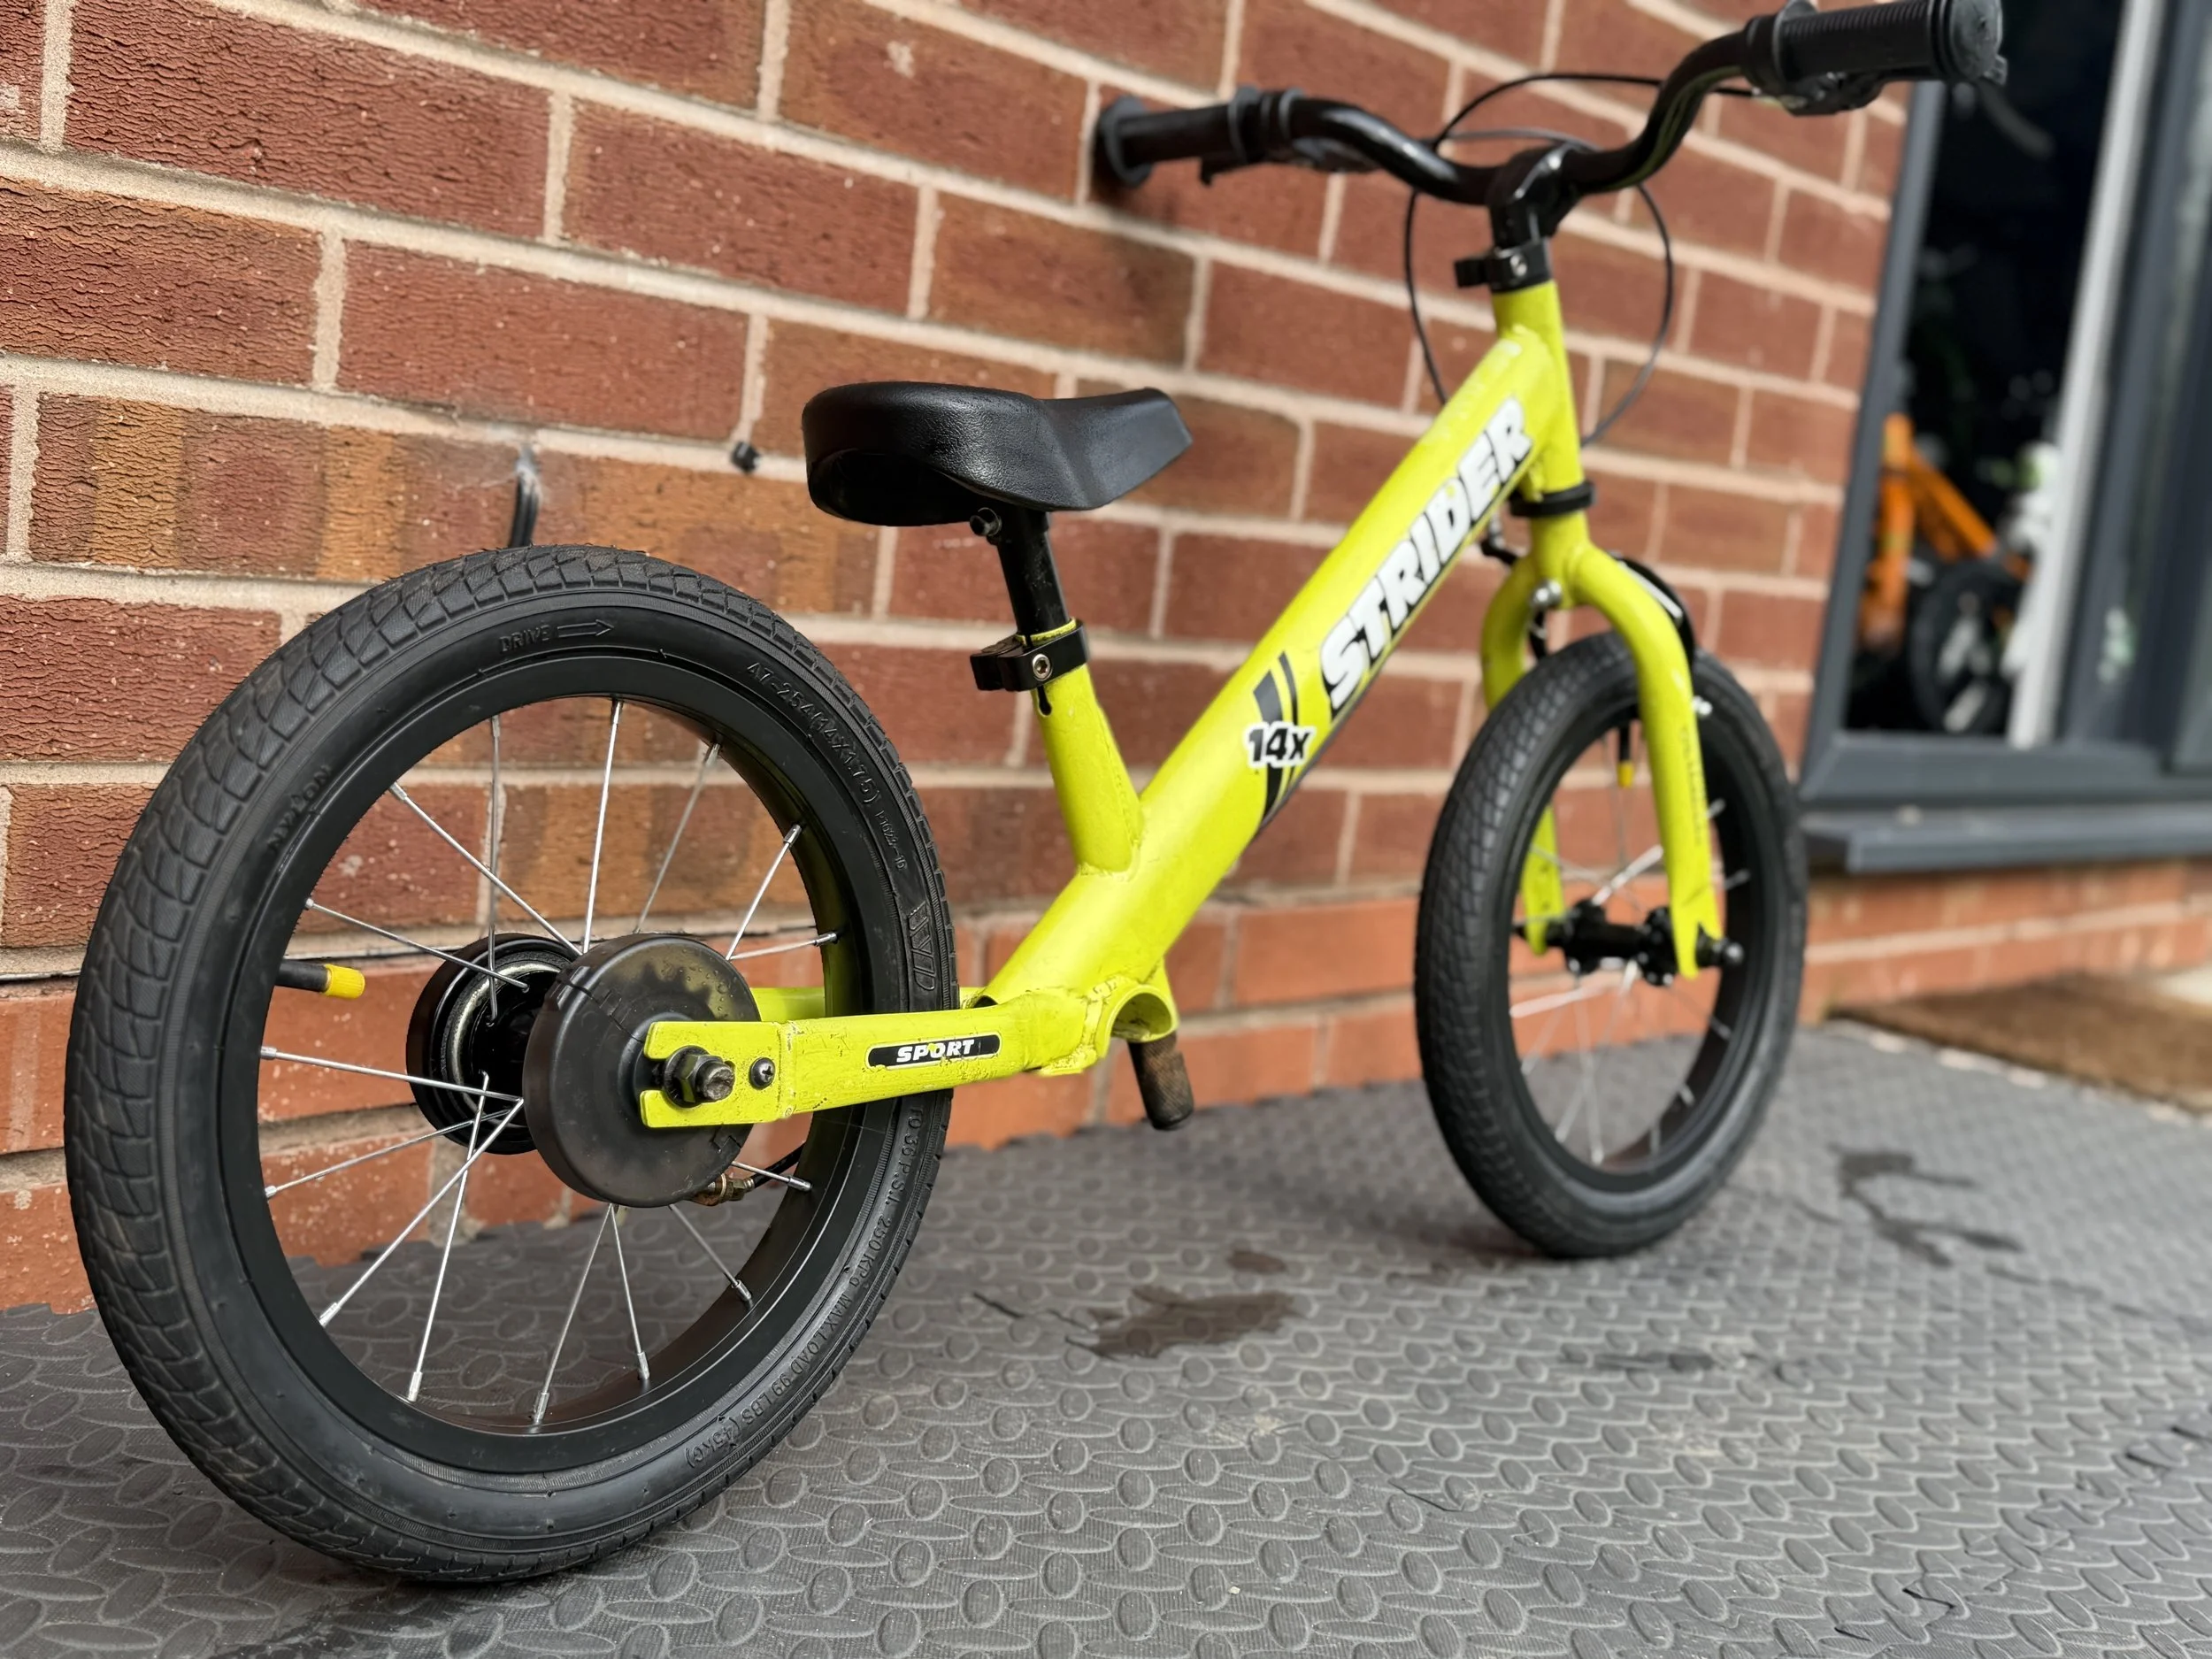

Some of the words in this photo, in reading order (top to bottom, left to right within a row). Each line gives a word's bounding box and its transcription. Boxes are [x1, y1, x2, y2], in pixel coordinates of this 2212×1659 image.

[1321, 397, 1533, 709] STRIDER
[499, 624, 550, 652] DRIVE
[267, 764, 333, 851] NYLON
[896, 1040, 974, 1063] SPORT
[902, 1133, 918, 1157] 36
[772, 1373, 792, 1396] 99
[741, 1392, 772, 1425] LBS
[685, 1417, 741, 1469] (45KG)
